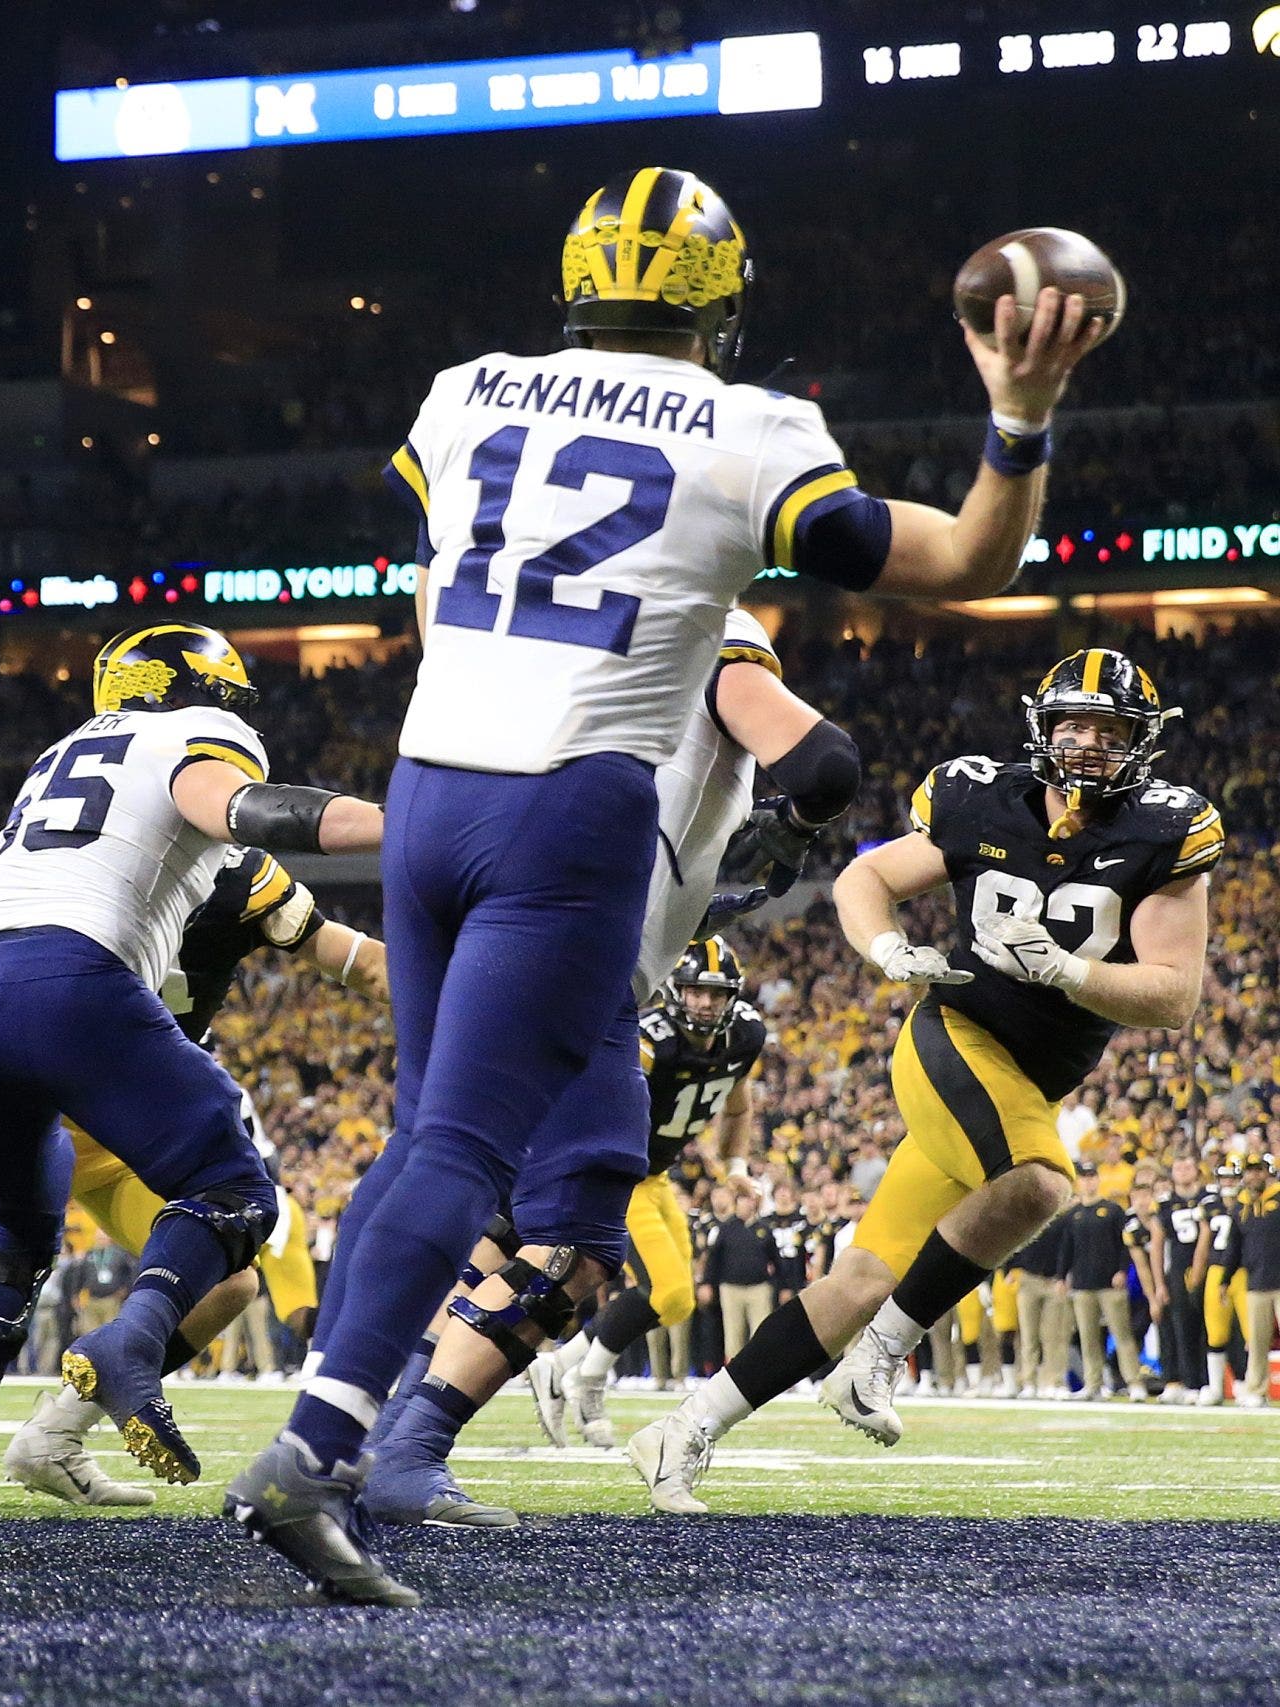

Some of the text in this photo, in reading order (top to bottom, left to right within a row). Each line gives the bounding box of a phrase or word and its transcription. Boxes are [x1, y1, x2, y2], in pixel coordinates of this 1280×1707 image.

[465, 367, 717, 440] McNAMARA
[433, 424, 677, 657] 12
[1142, 526, 1228, 562] FIND
[205, 569, 281, 602] FIND
[284, 565, 377, 599] YOUR
